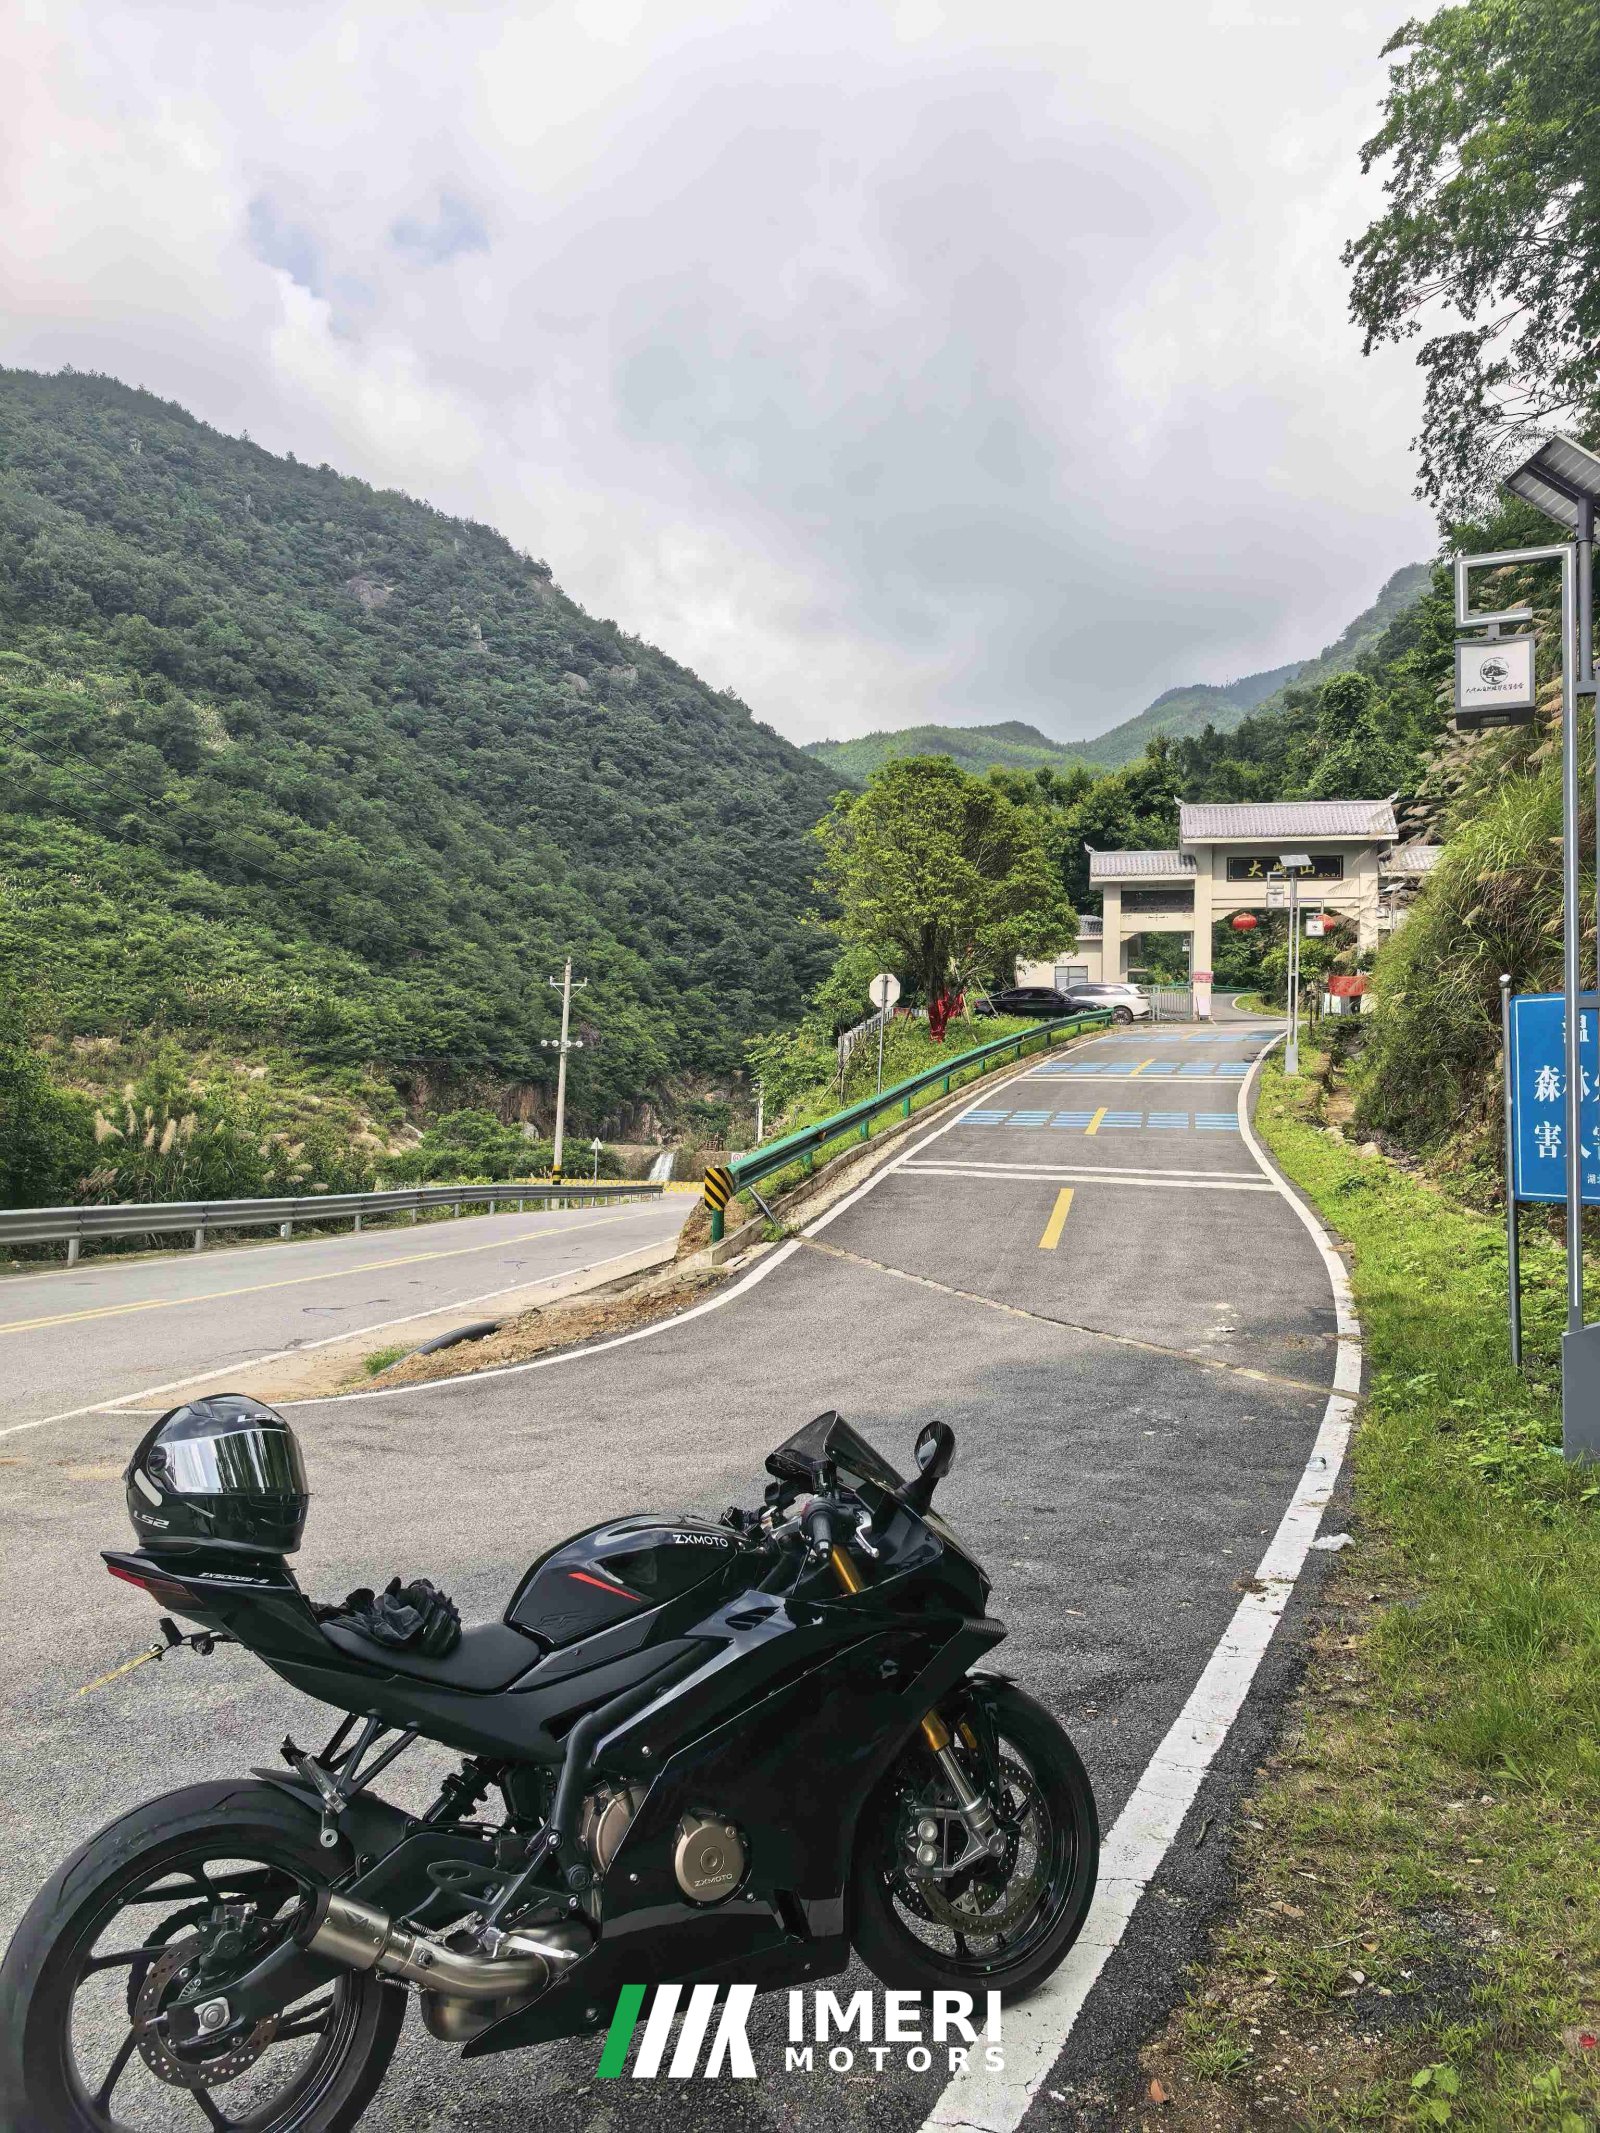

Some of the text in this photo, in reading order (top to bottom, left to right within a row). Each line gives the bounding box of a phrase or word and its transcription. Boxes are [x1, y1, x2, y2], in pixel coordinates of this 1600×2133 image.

[133, 1510, 170, 1529] LS2
[672, 1534, 729, 1548] ZXMOTO
[694, 1873, 733, 1887] ZXMOTO
